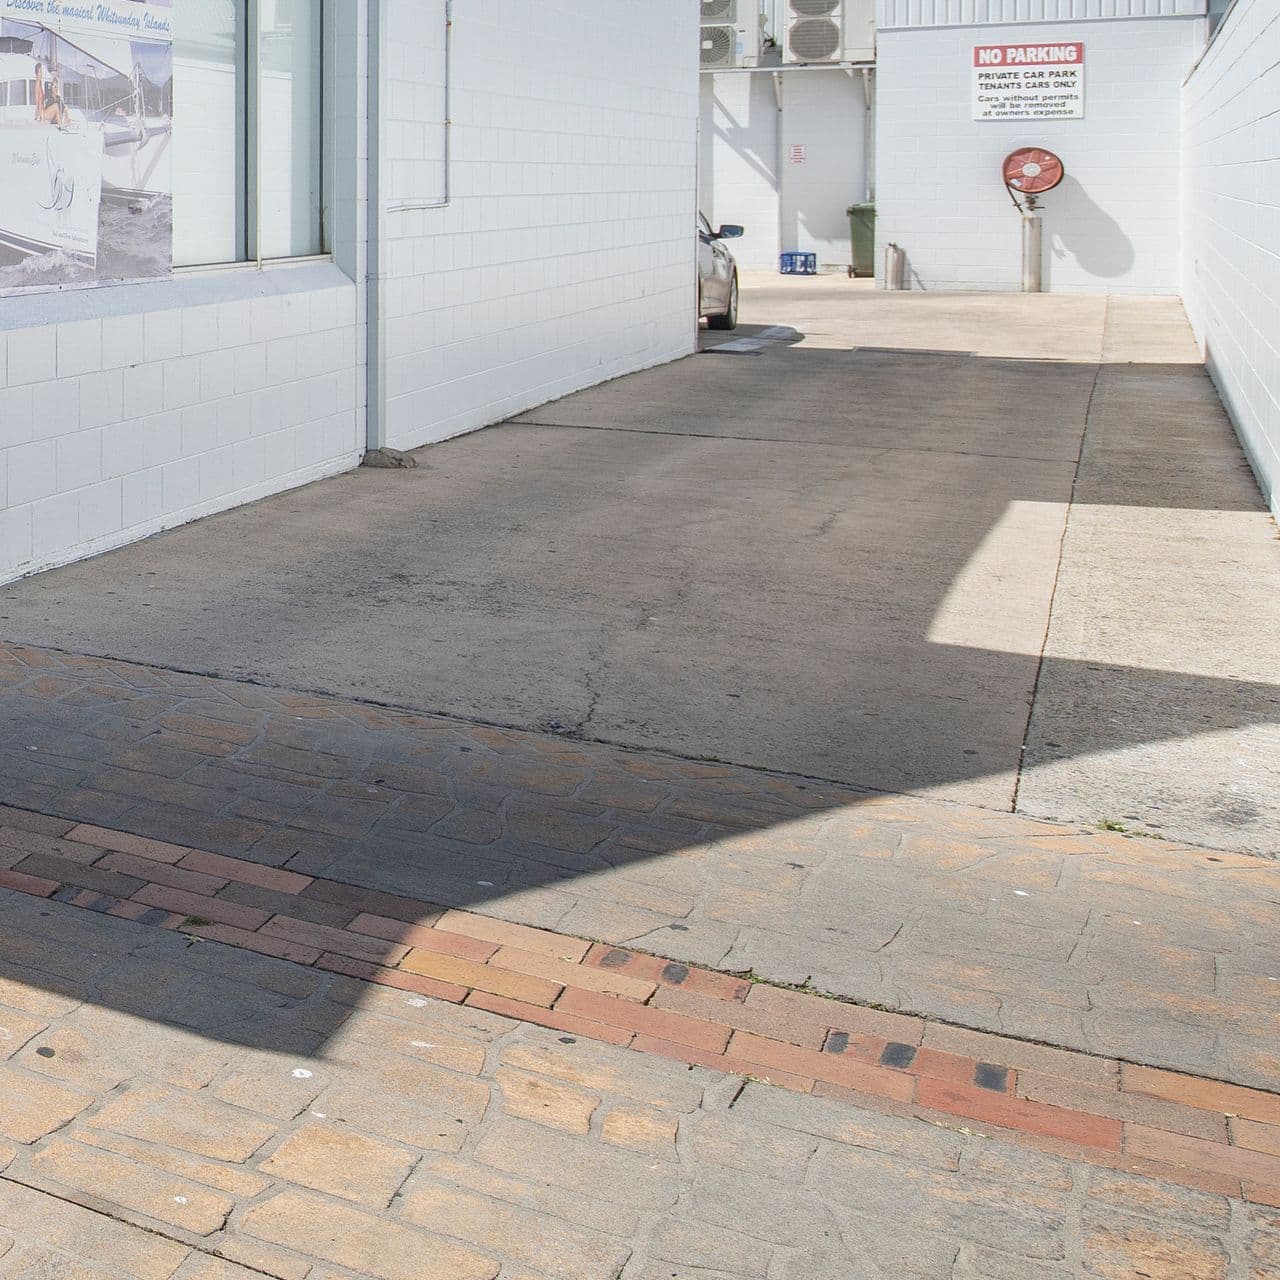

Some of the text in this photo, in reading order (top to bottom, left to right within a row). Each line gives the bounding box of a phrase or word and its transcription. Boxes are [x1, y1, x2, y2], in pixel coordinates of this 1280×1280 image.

[47, 1, 60, 13] the
[63, 6, 93, 20] magical
[97, 5, 140, 30] Whitsunday
[144, 17, 170, 32] Islands
[979, 46, 1077, 64] NO PARKING
[978, 72, 1020, 80] PRIVATE
[979, 82, 1021, 90] TENANTS
